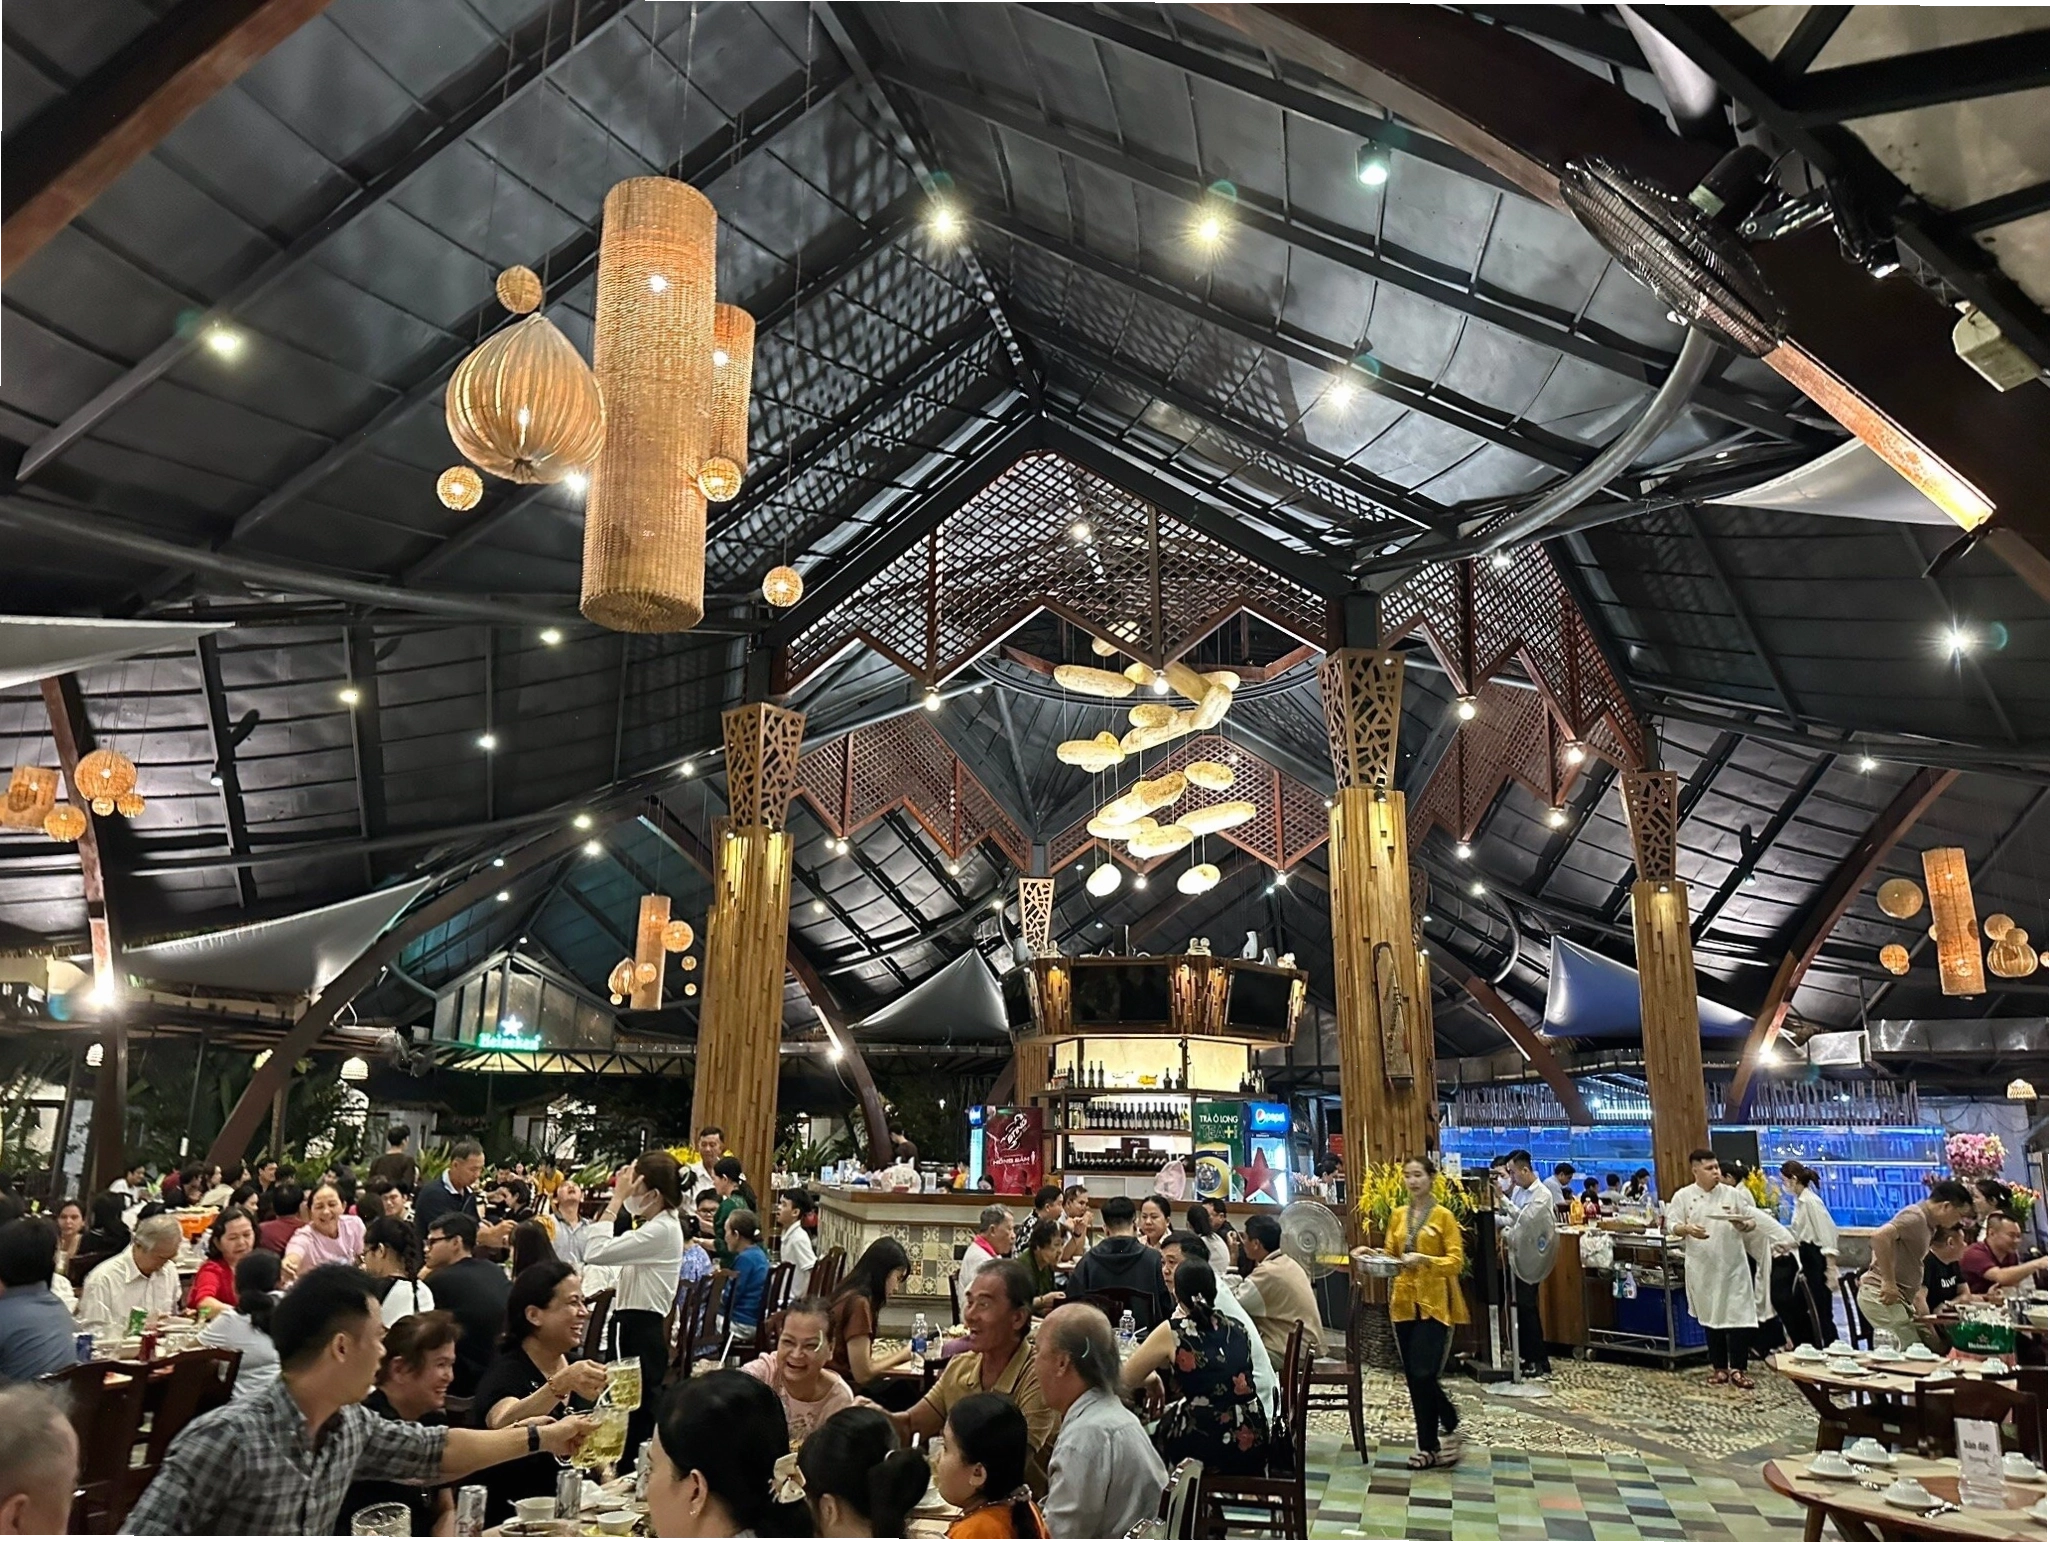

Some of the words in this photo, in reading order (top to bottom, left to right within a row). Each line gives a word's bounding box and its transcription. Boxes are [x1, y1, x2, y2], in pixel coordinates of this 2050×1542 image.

[478, 1033, 541, 1051] Heineken
[1199, 1113, 1212, 1124] TRÀ
[1213, 1113, 1219, 1124] Ô
[1220, 1115, 1238, 1124] LONG
